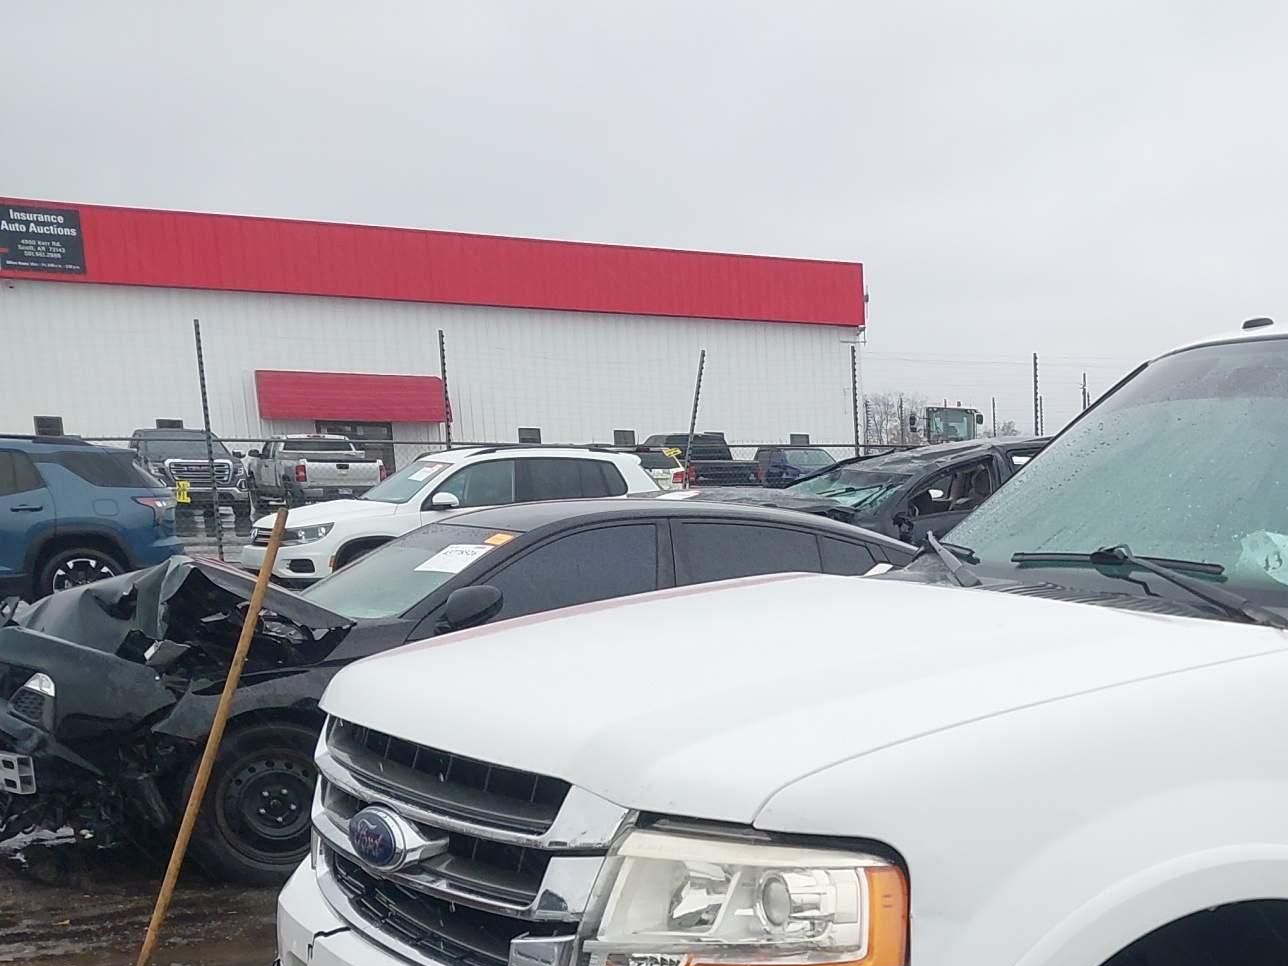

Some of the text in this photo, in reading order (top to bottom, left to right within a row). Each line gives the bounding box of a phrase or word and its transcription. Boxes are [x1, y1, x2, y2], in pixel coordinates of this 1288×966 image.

[9, 209, 64, 223] Insurance
[0, 220, 77, 236] Auto Auctions
